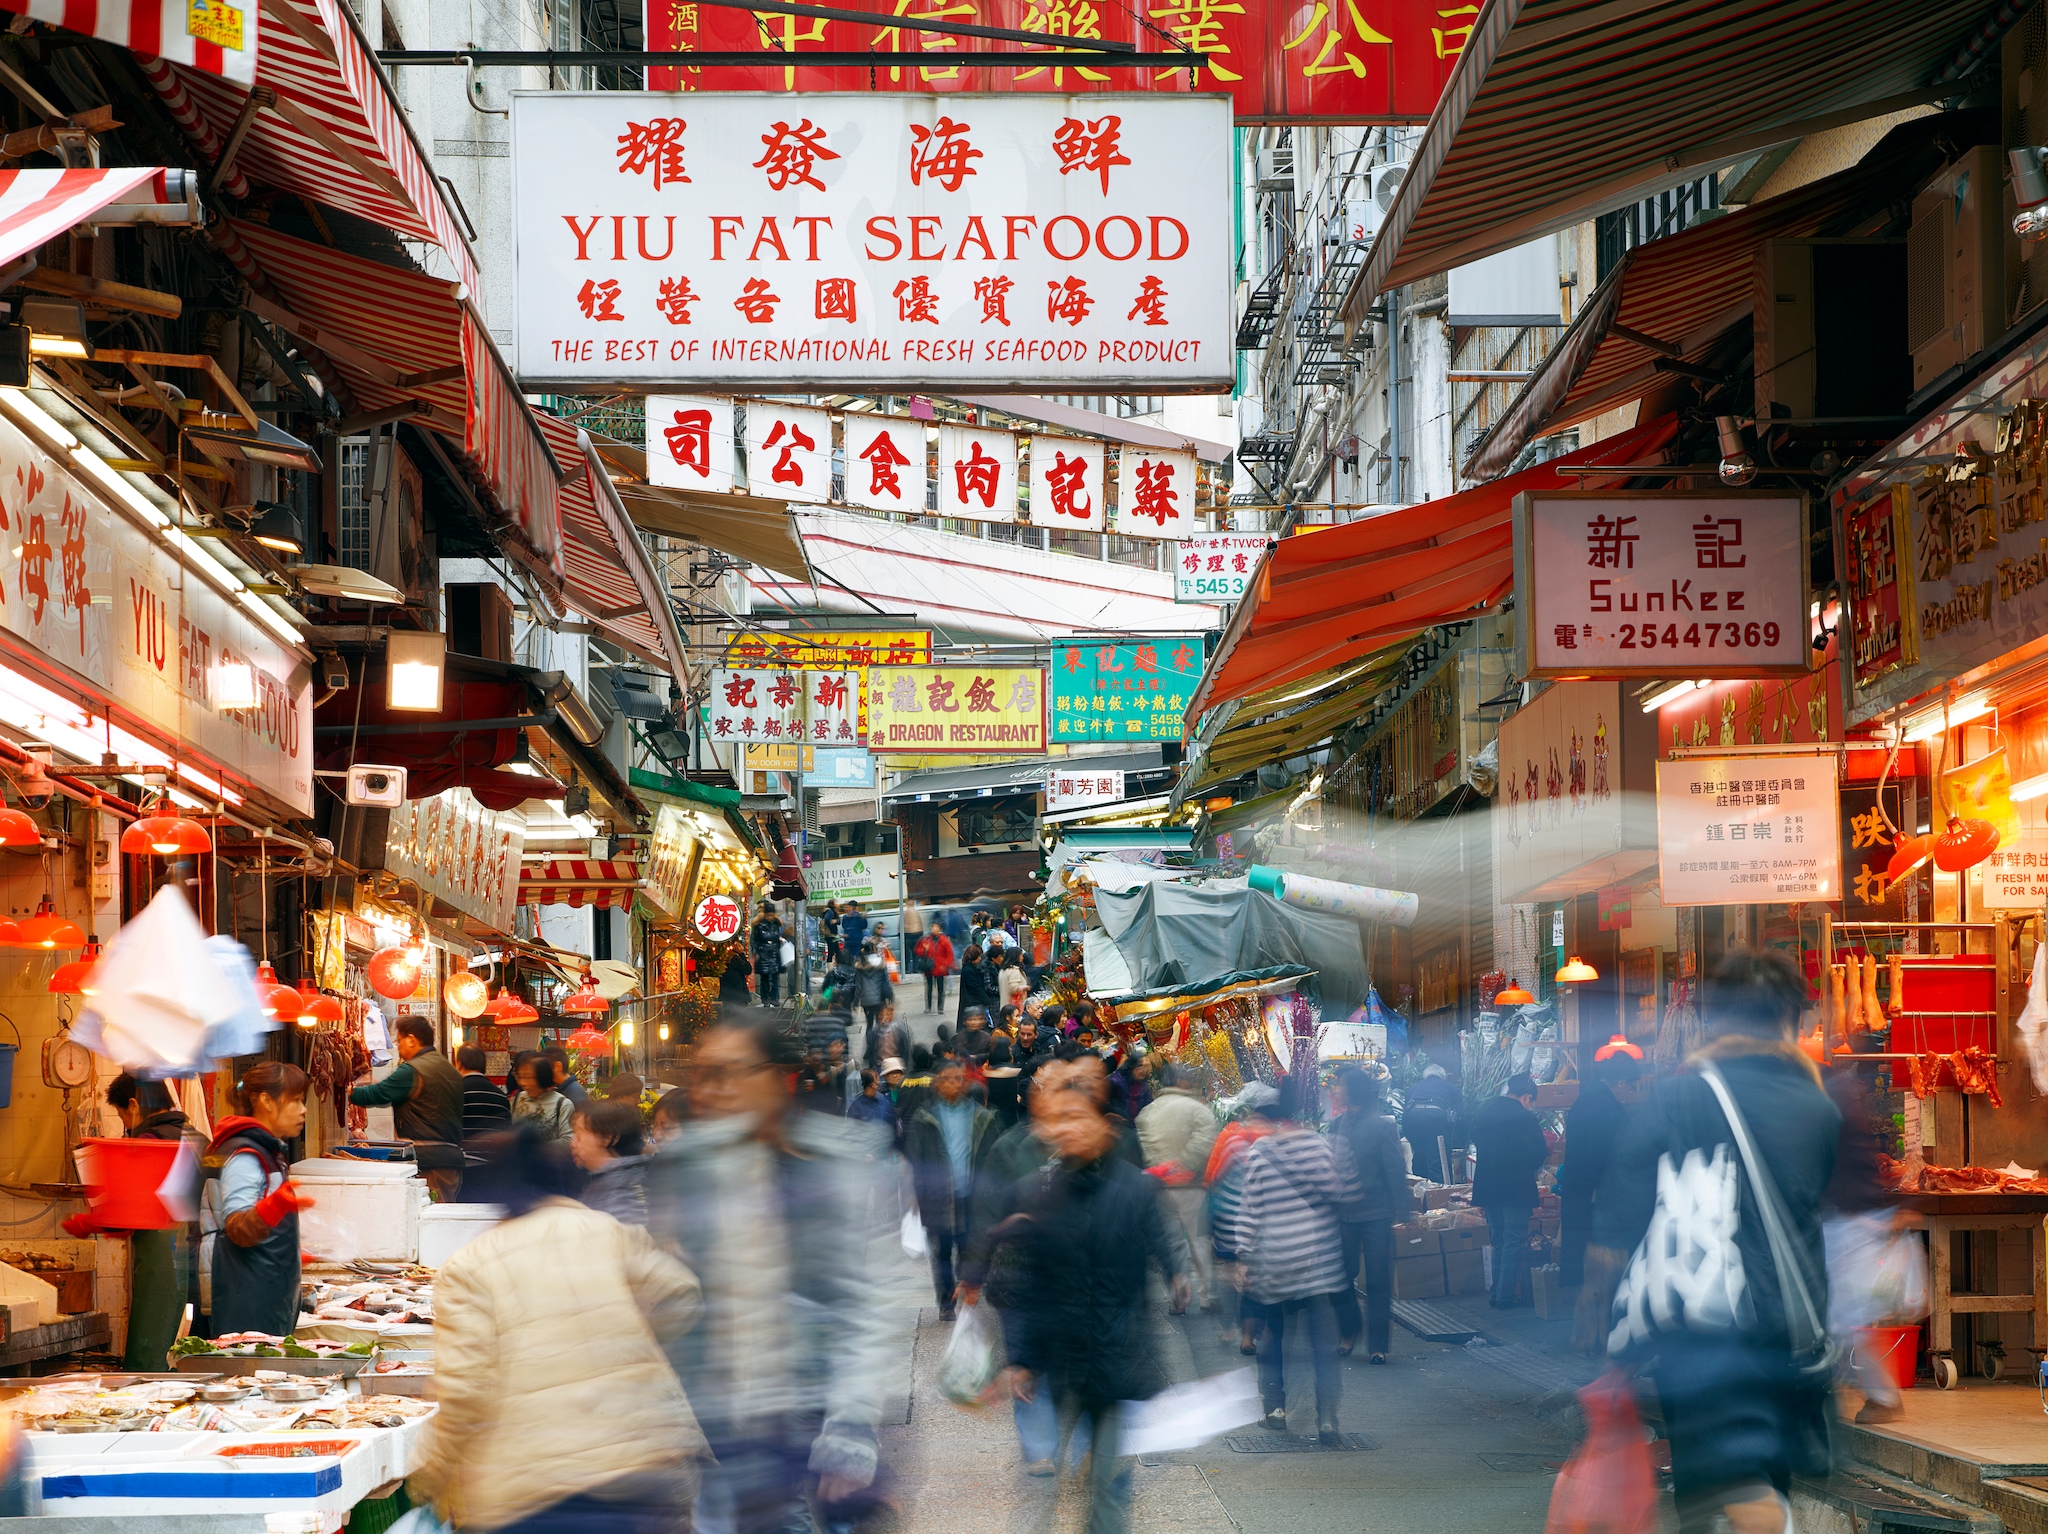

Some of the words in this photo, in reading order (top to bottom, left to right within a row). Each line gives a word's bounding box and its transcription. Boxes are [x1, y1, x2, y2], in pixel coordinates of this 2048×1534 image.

[616, 116, 1131, 197] 耀發海鮮
[561, 215, 676, 262] YIU
[709, 215, 833, 262] FAT
[865, 214, 1190, 262] SEAFOOD
[576, 275, 1169, 327] 經營各國優質海產
[551, 338, 593, 363] THE
[605, 338, 659, 363] BEST
[669, 338, 699, 363] OF
[712, 338, 891, 363] INTERNATIONAL
[903, 338, 975, 363] FRESH
[985, 338, 1088, 363] SEAFOOD
[1098, 338, 1201, 363] PRODUCT
[1209, 537, 1231, 550] 世界
[1587, 514, 1747, 569] 新記
[0, 461, 91, 656] 海鮮
[1182, 552, 1263, 574] 修理電
[1196, 578, 1229, 595] 545
[130, 576, 166, 672] YIU
[178, 613, 210, 700] FAT
[888, 675, 1037, 713] 龍記飯店
[1150, 713, 1185, 725] 5459
[889, 723, 943, 742] DRAGON
[950, 723, 1039, 742] RESTAURANT
[1057, 778, 1113, 796] 蘭芳園
[1690, 778, 1806, 794] 香港中醫管理委員會
[1716, 793, 1780, 807] 註冊中醫師
[1850, 806, 1893, 904] 跌打
[810, 878, 849, 891] VILLAGE
[1995, 873, 2031, 883] FRESH
[2003, 886, 2026, 896] FOR
[698, 897, 739, 937] 麵
